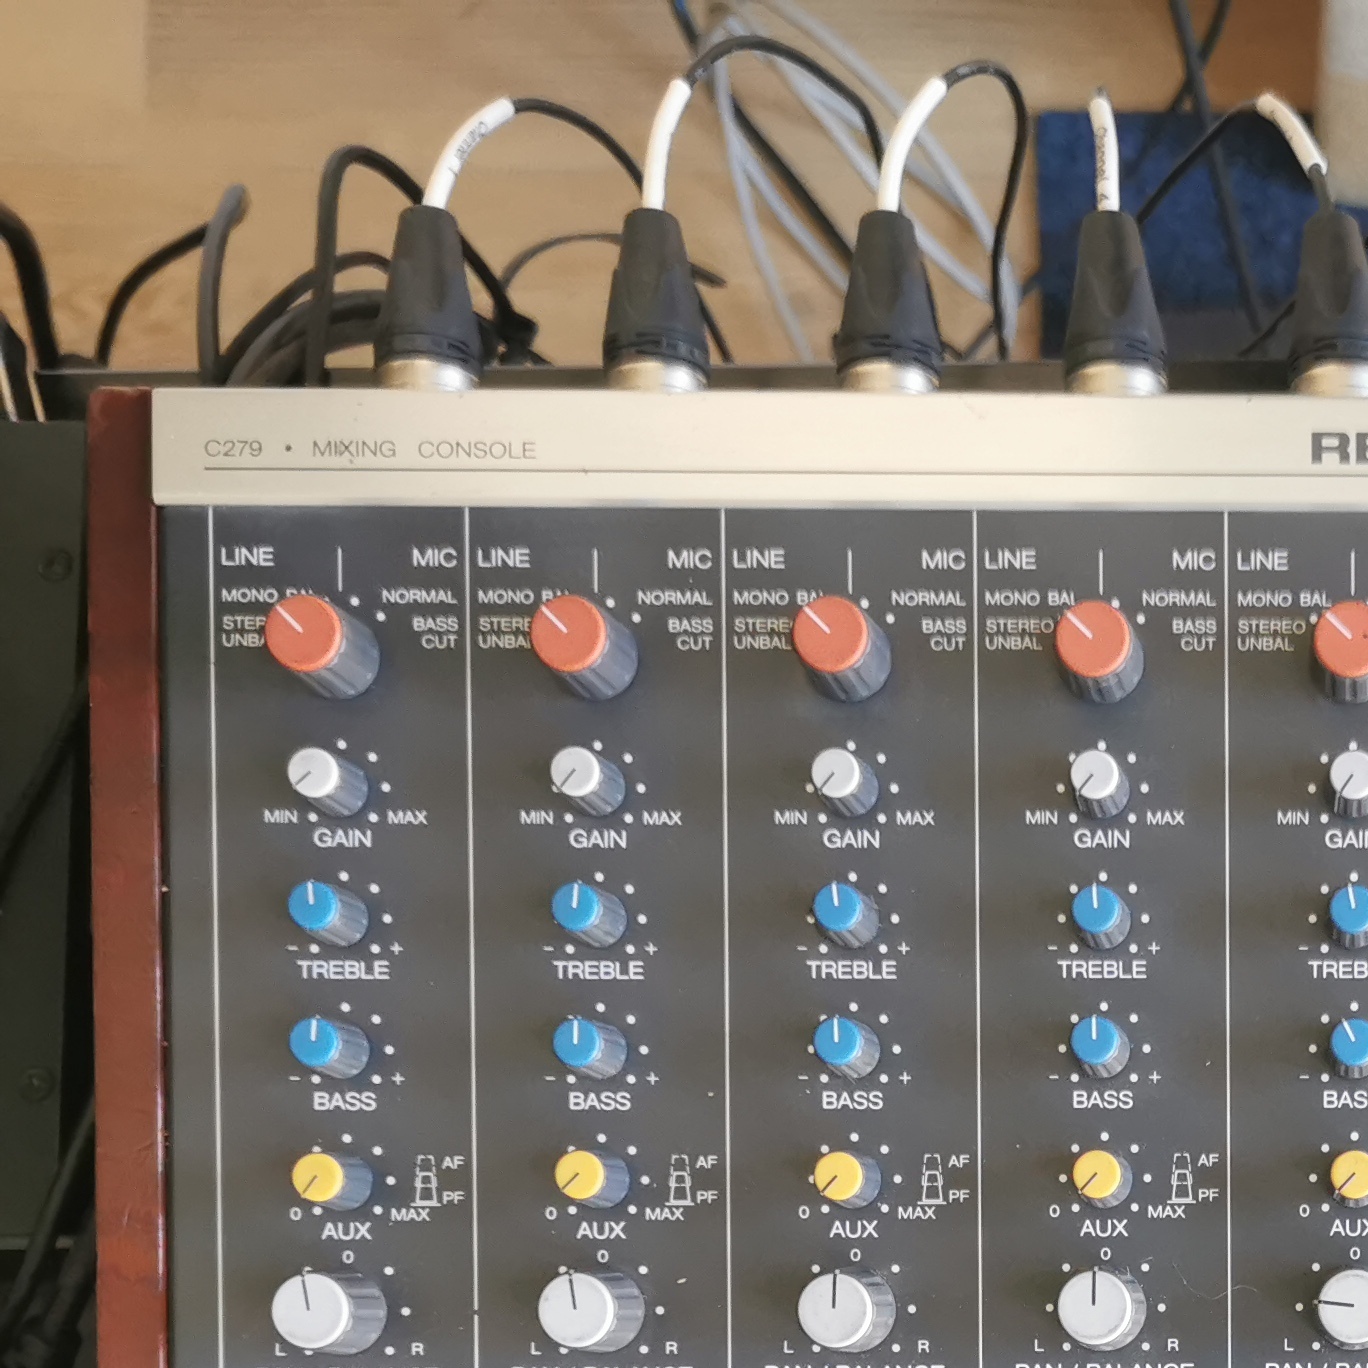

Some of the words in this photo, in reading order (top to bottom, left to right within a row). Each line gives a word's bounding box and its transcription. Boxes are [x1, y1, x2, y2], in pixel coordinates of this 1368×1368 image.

[204, 440, 262, 457] C279
[313, 439, 396, 458] MIXING
[418, 441, 535, 459] CONSOLE
[221, 546, 274, 566] LINE
[413, 547, 457, 567] MIC
[478, 547, 530, 567] LINE
[668, 549, 712, 569] MIC
[733, 548, 785, 568] LINE
[922, 550, 965, 570] MIC
[985, 549, 1036, 569] LINE
[1173, 549, 1216, 570] MIC
[1237, 550, 1288, 570] LINE
[382, 588, 457, 603] NORMAL
[637, 590, 712, 605] NORMAL
[734, 589, 789, 605] MONO
[892, 590, 966, 606] NORMAL
[1142, 590, 1216, 606] NORMAL
[264, 809, 298, 823] MIN
[387, 810, 427, 824] MAX
[313, 828, 371, 847] GAIN
[569, 828, 626, 848] GAIN
[823, 829, 879, 848] GAIN
[1074, 828, 1130, 848] GAIN
[297, 960, 390, 979] TREBLE
[553, 961, 644, 979] TREBLE
[806, 960, 897, 979] TREBLE
[1057, 960, 1147, 978] TREBLE
[313, 1092, 377, 1111] BASS
[569, 1092, 631, 1110] BASS
[822, 1091, 883, 1109] BASS
[1073, 1090, 1133, 1109] BASS
[322, 1222, 372, 1240] AUX
[576, 1222, 626, 1239] AUX
[830, 1220, 878, 1238] AUX
[1080, 1219, 1128, 1237] AUX
